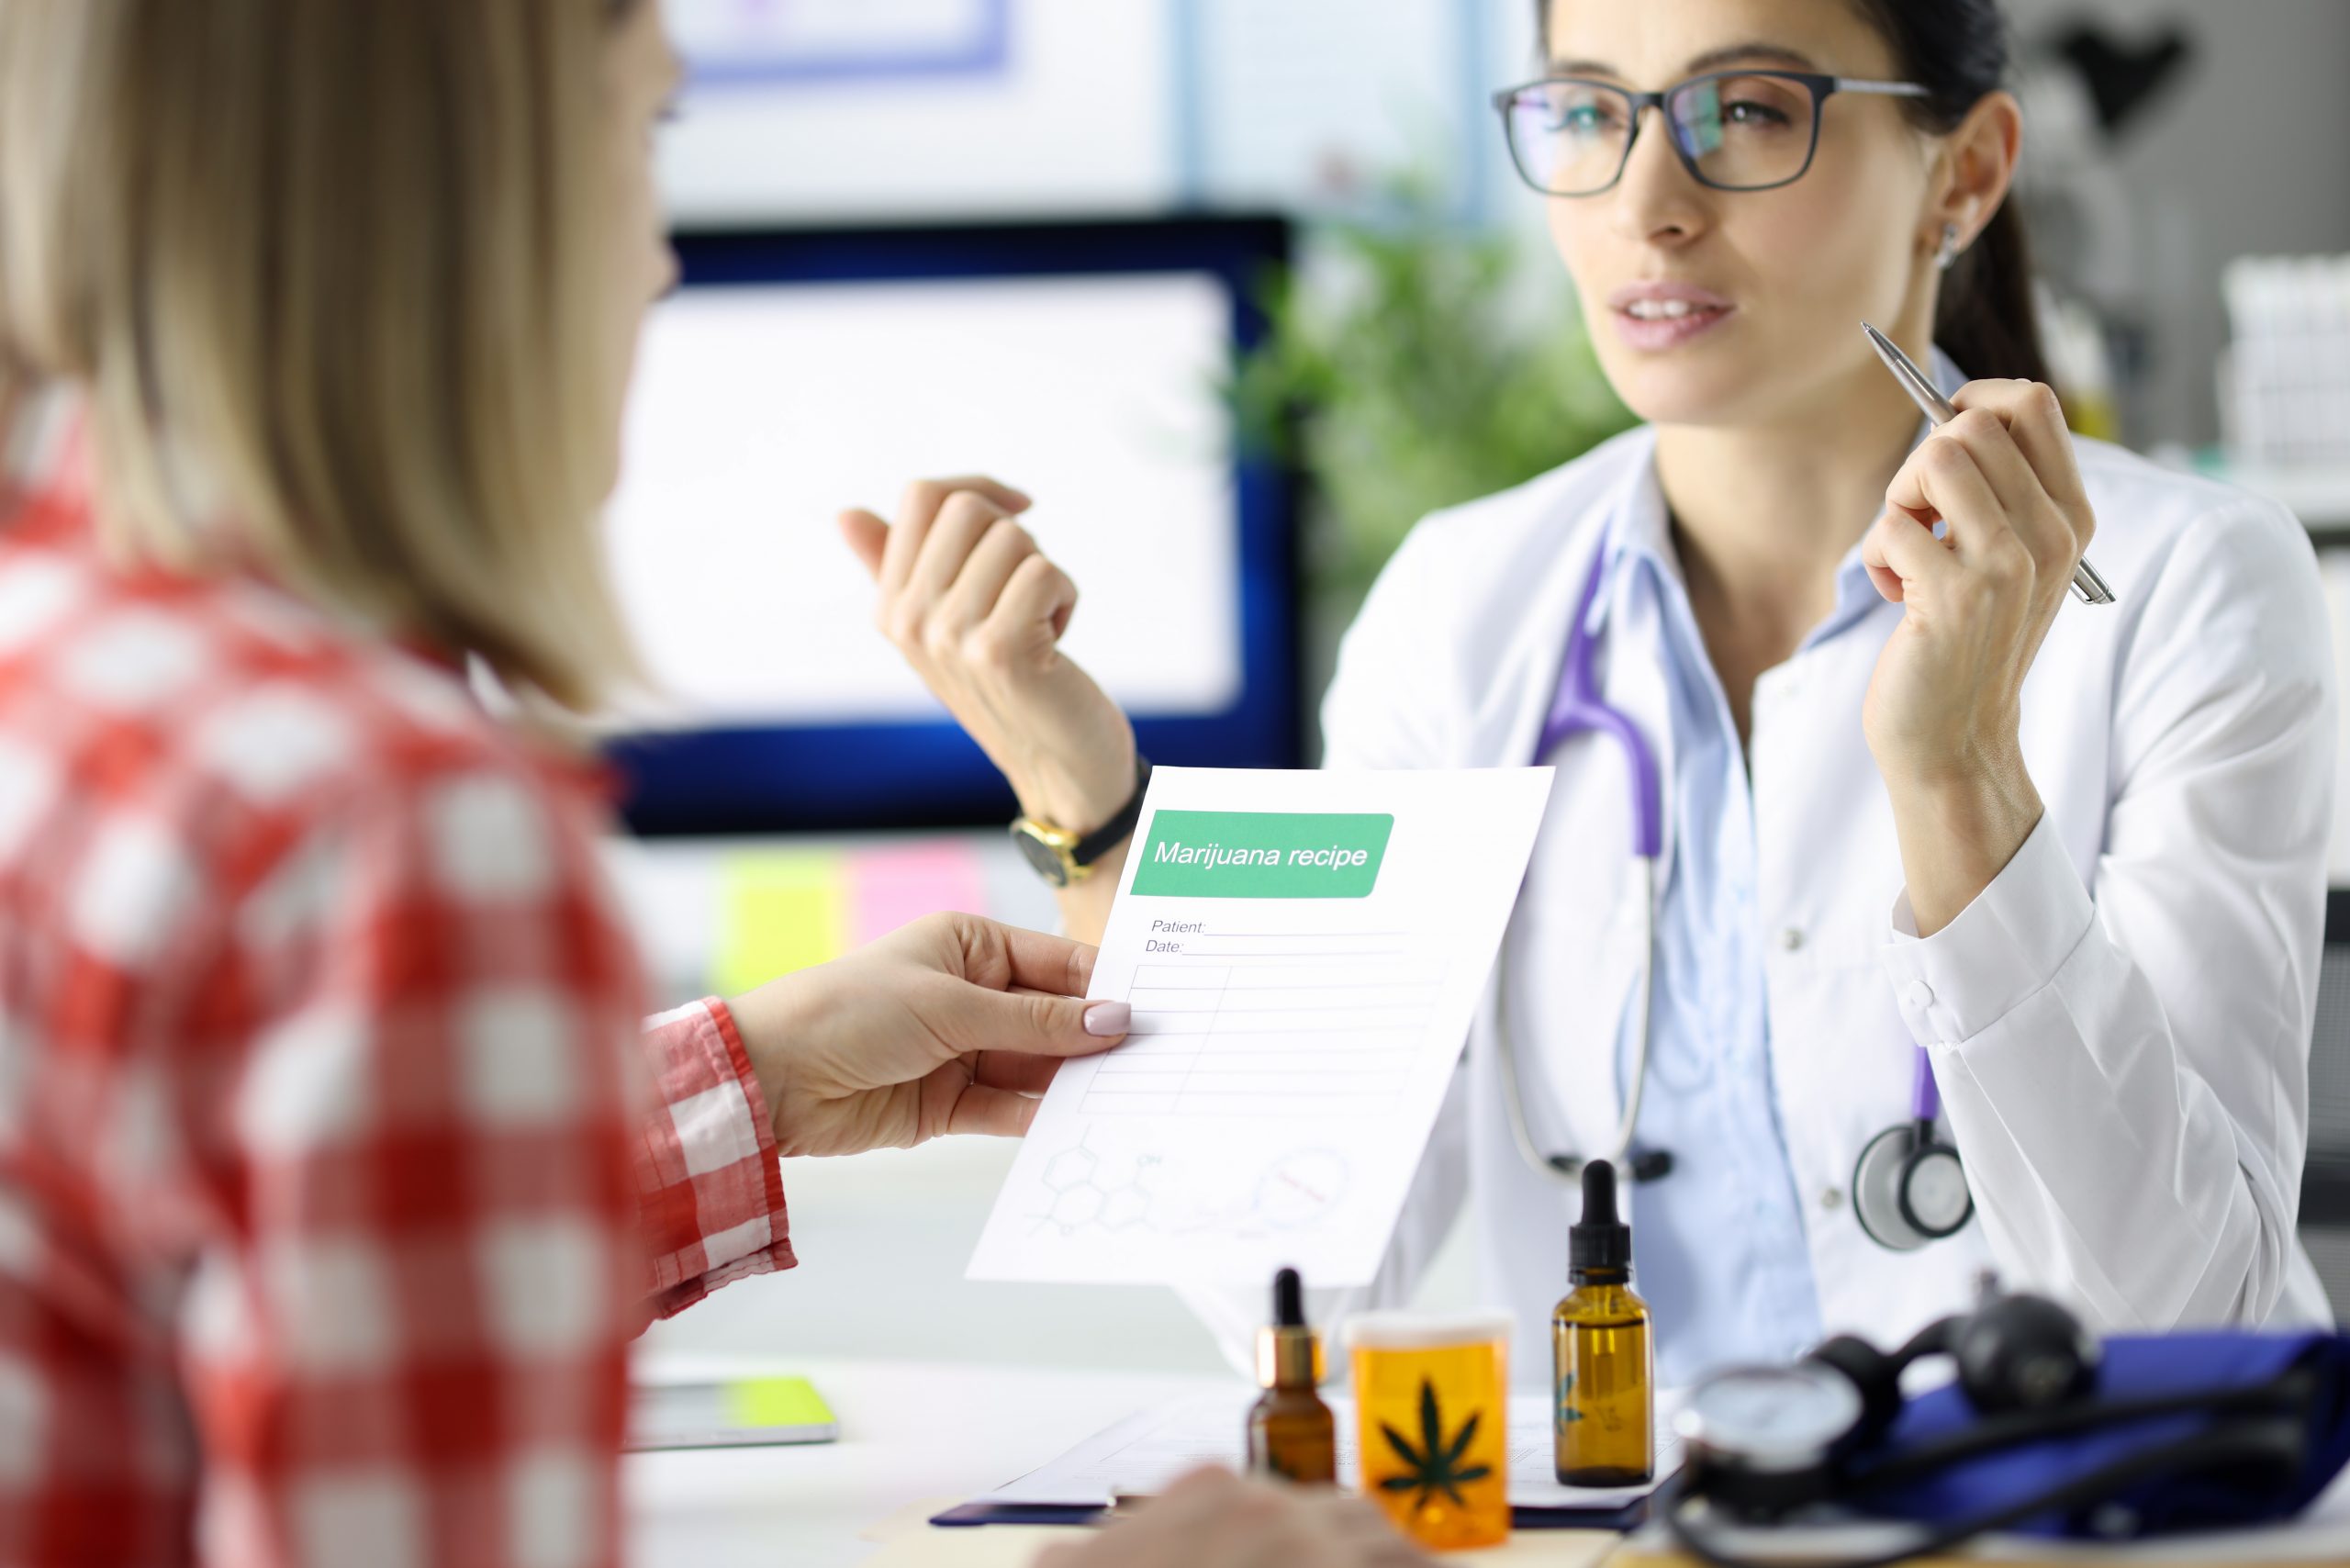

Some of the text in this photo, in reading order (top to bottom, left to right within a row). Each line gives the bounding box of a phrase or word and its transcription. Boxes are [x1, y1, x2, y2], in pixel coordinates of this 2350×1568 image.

[1153, 841, 1368, 870] Marijuana recipe
[1150, 920, 1206, 934] Patient:
[1146, 939, 1184, 953] Date:
